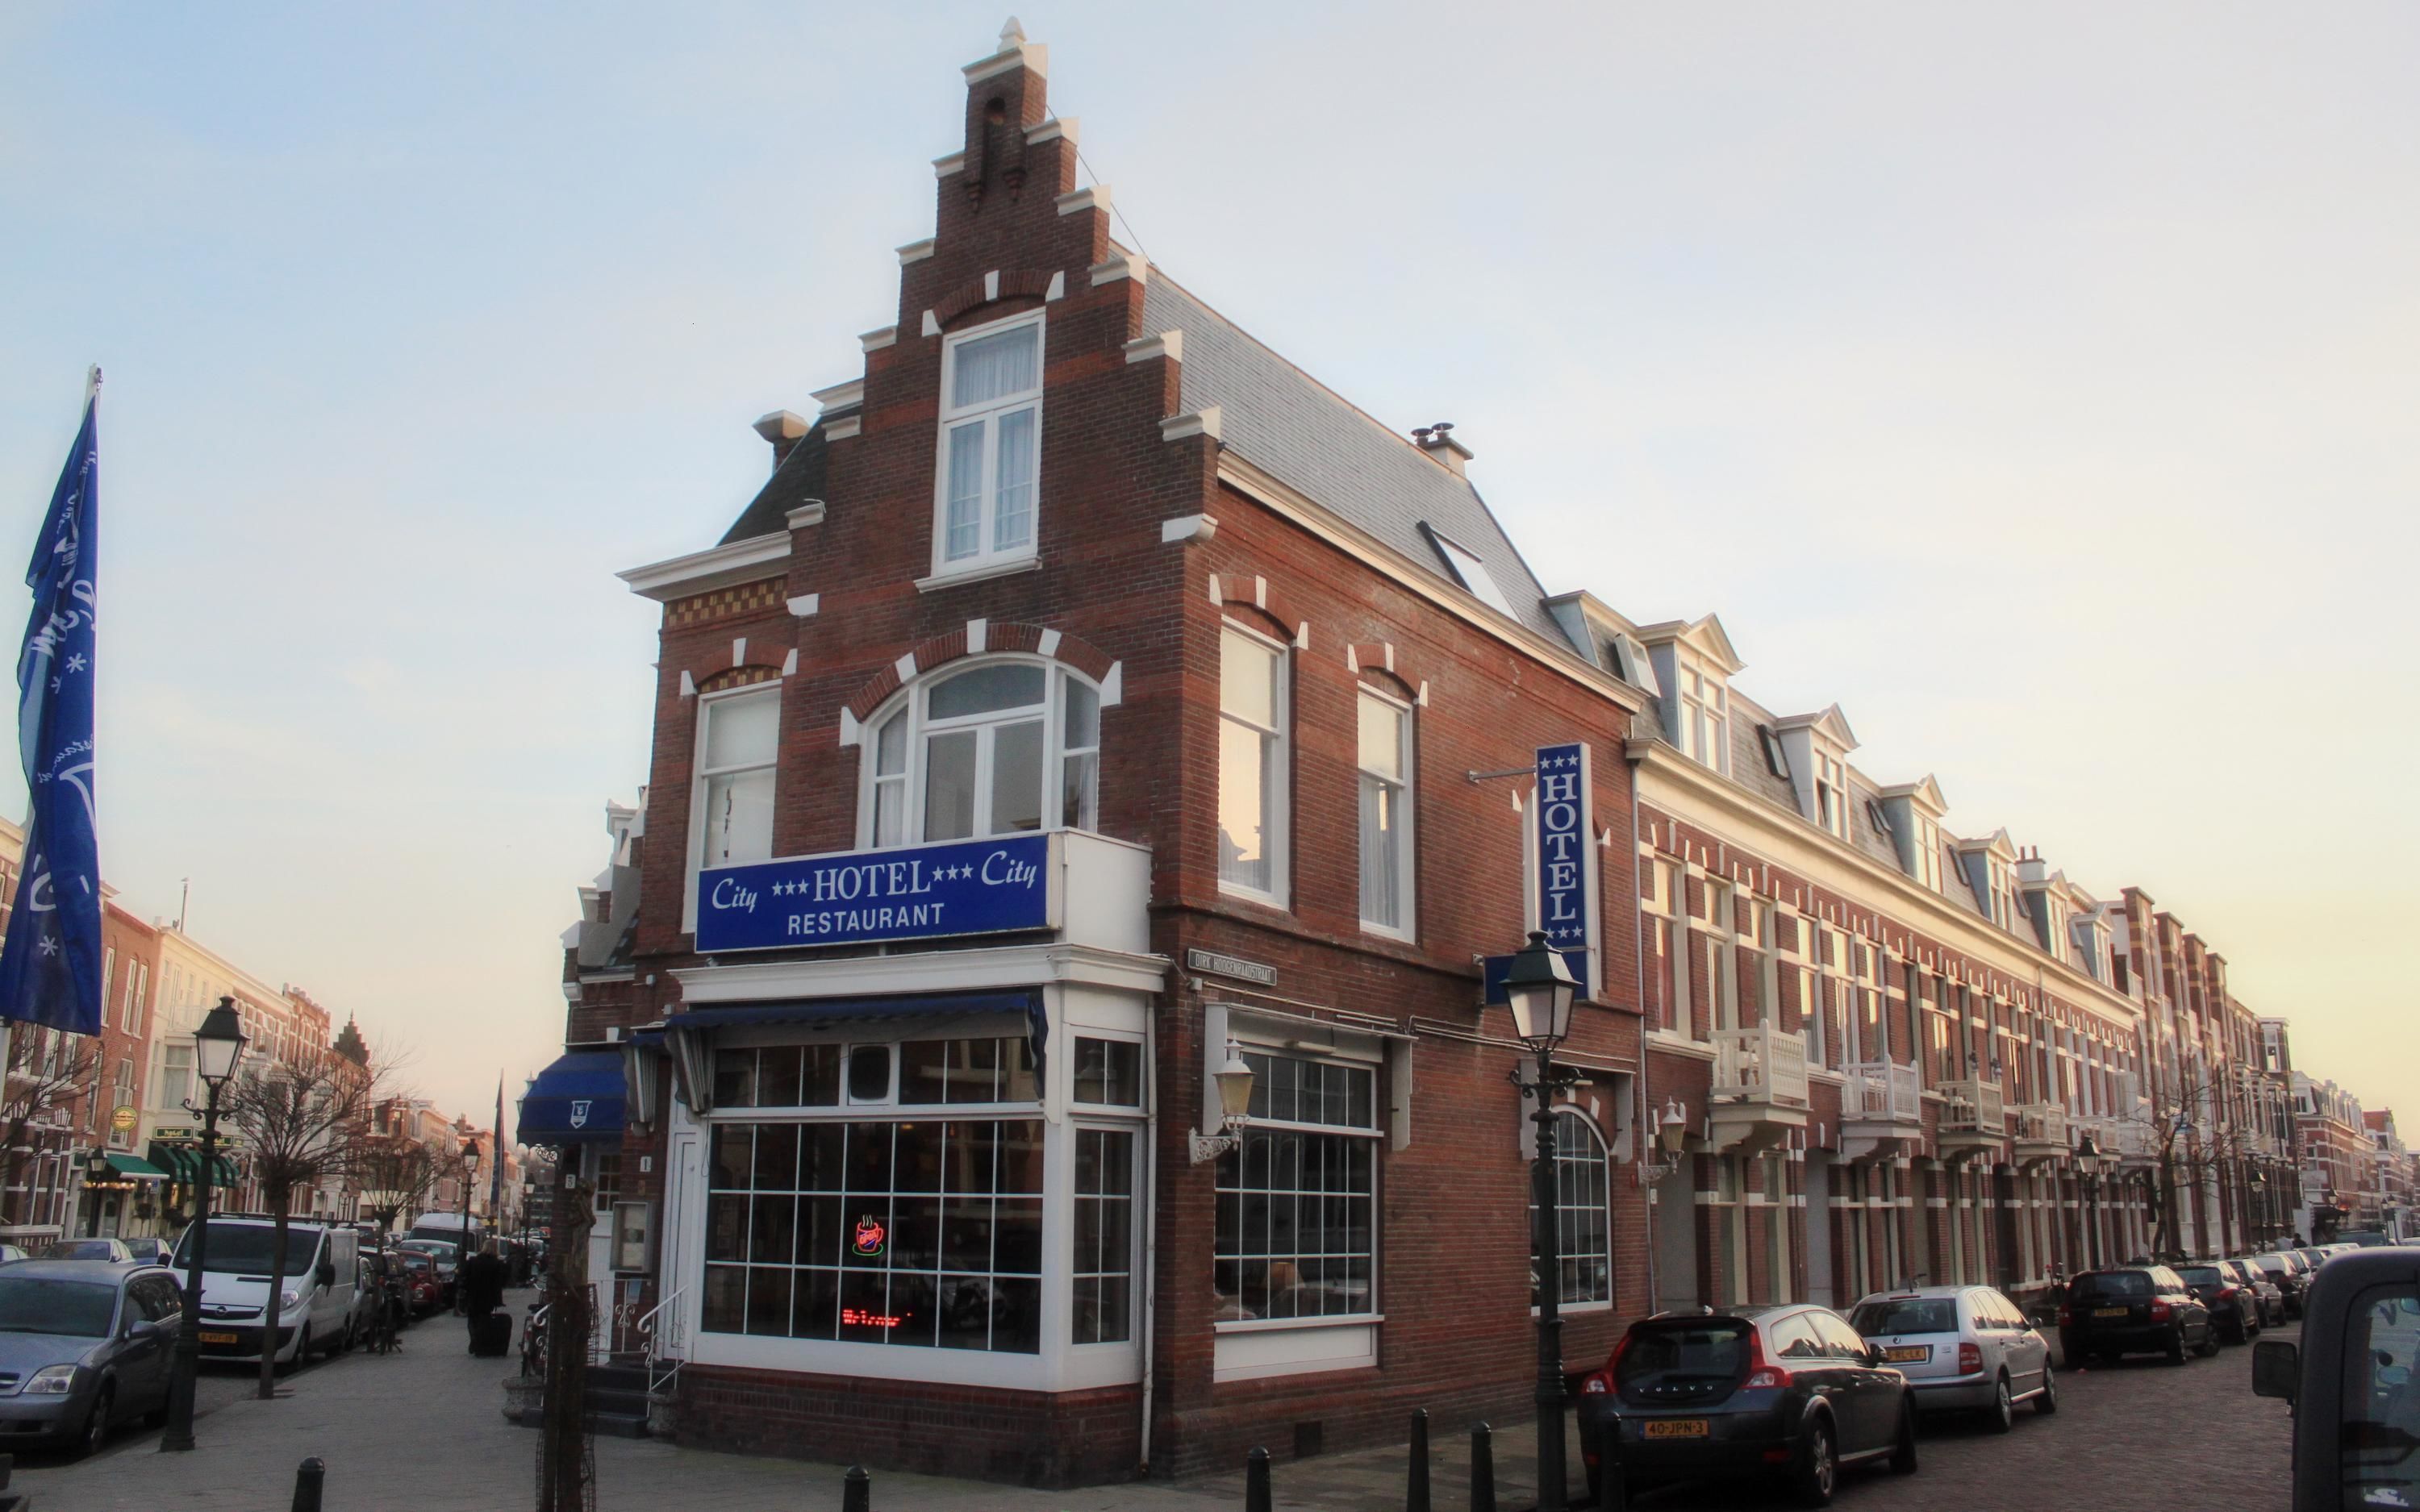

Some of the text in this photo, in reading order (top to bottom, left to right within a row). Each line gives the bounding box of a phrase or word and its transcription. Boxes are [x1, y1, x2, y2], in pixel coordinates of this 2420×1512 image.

[1542, 773, 1577, 921] HOTEL
[712, 850, 1037, 913] City HOTEL City
[787, 903, 945, 935] RESTAURANT
[1195, 953, 1210, 968] DIRK
[1639, 1385, 1713, 1393] VOLVO
[1649, 1421, 1704, 1435] 40-JPN-3
